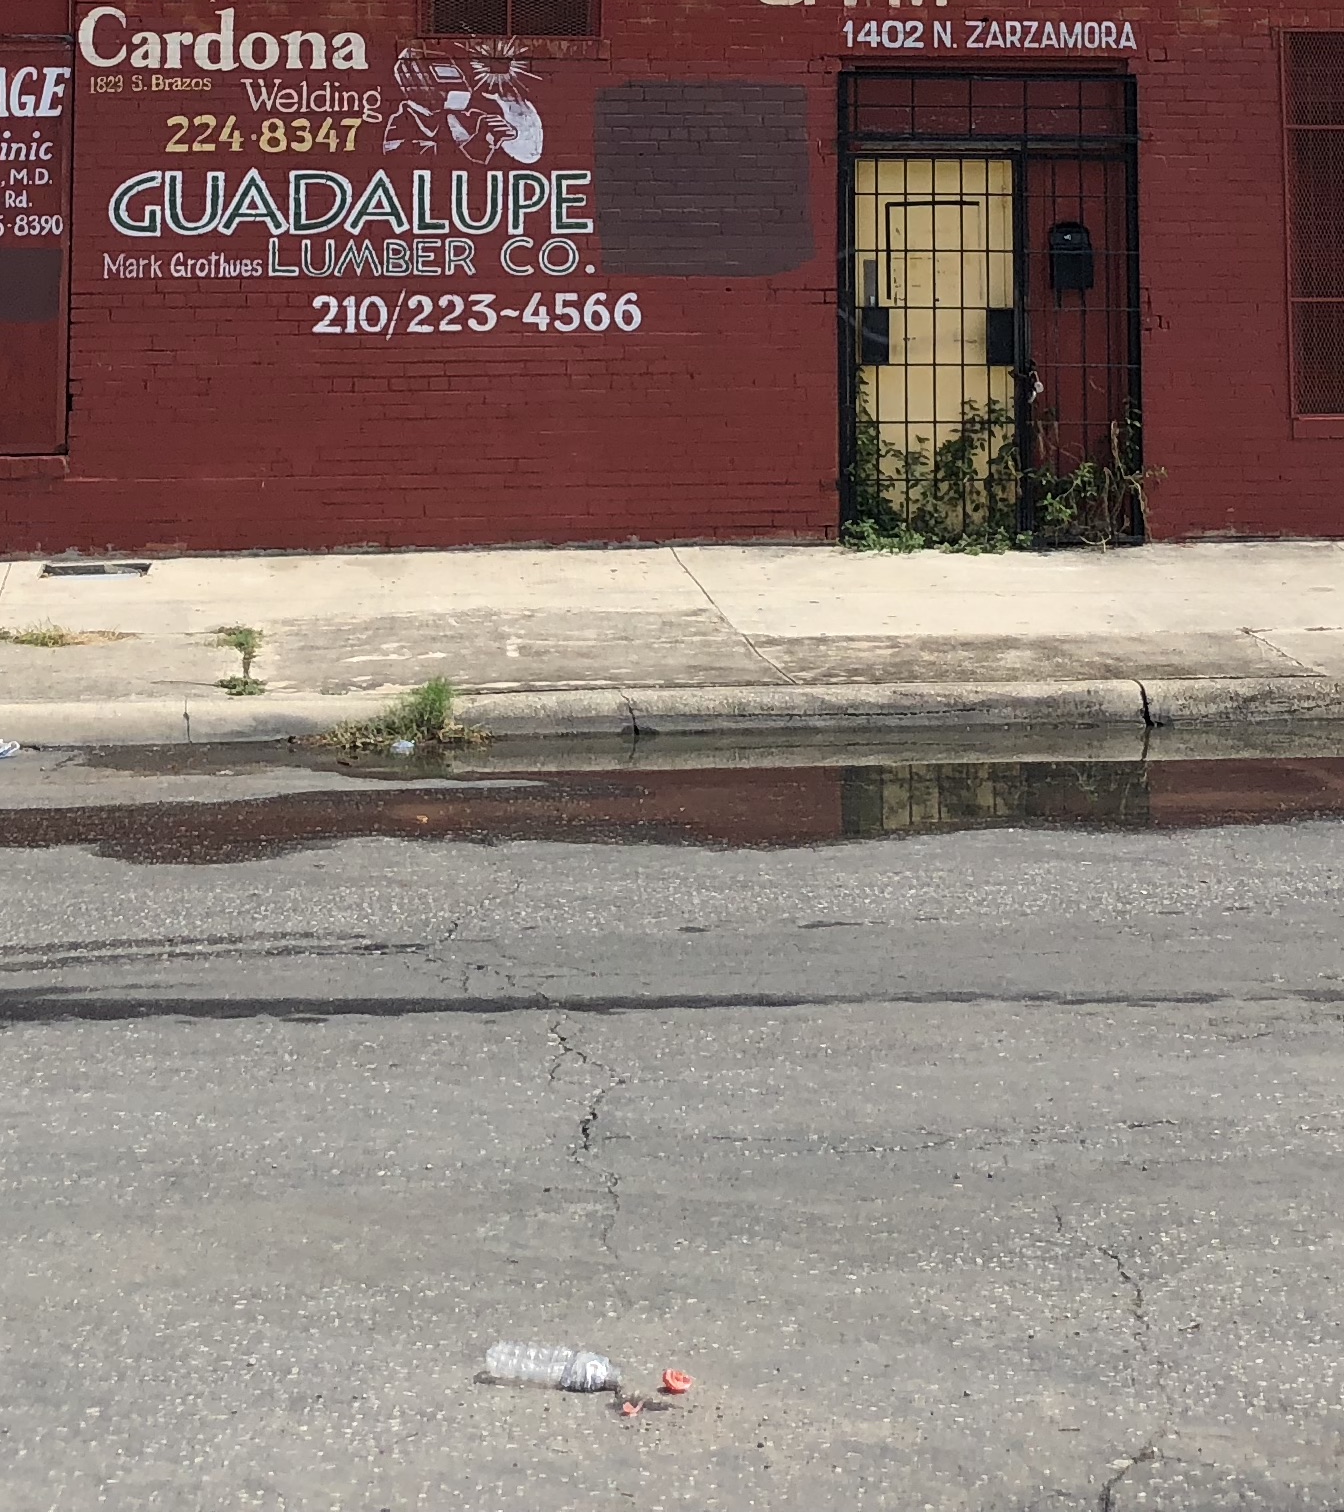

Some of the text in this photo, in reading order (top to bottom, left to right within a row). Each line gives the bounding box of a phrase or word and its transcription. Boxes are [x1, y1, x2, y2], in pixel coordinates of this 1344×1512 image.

[78, 6, 369, 72] Cardona
[842, 20, 1138, 51] 1402 N. ZARZAMORA
[89, 75, 124, 94] 1823
[151, 74, 212, 92] Brazos
[240, 78, 383, 123] Welding
[9, 168, 54, 186] M.D.
[5, 190, 33, 208] Rd.
[108, 167, 594, 238] GUADALUPE
[102, 252, 263, 279] Mark Grothues
[267, 236, 597, 279] LUMBER CO.
